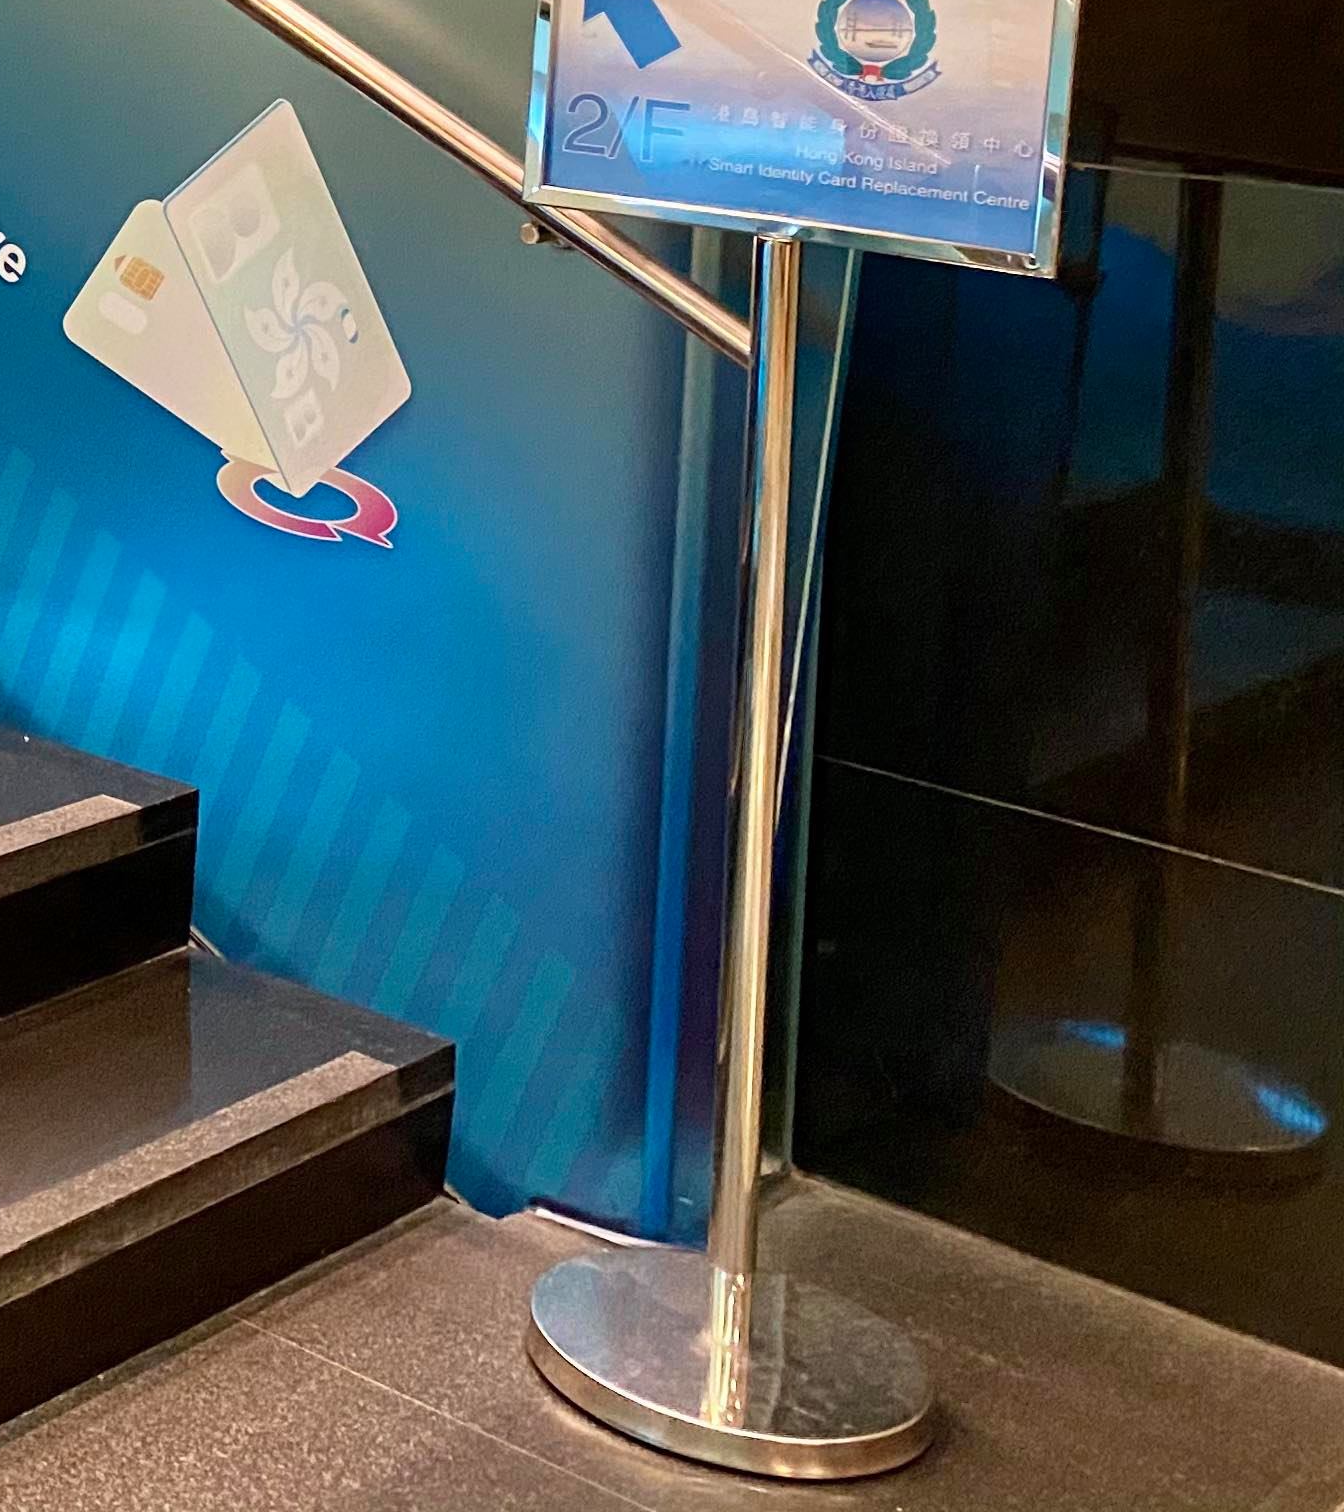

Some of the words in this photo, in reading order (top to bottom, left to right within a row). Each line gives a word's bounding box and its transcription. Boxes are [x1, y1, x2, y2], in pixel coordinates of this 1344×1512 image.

[562, 91, 691, 163] 2/F
[711, 157, 754, 176] Smart
[758, 163, 813, 186] Identity
[818, 170, 857, 189] Card
[861, 177, 969, 203] Replacement
[973, 190, 1030, 211] Centre
[795, 144, 838, 166] Hong
[843, 149, 884, 172] Kong
[889, 154, 938, 176] Island
